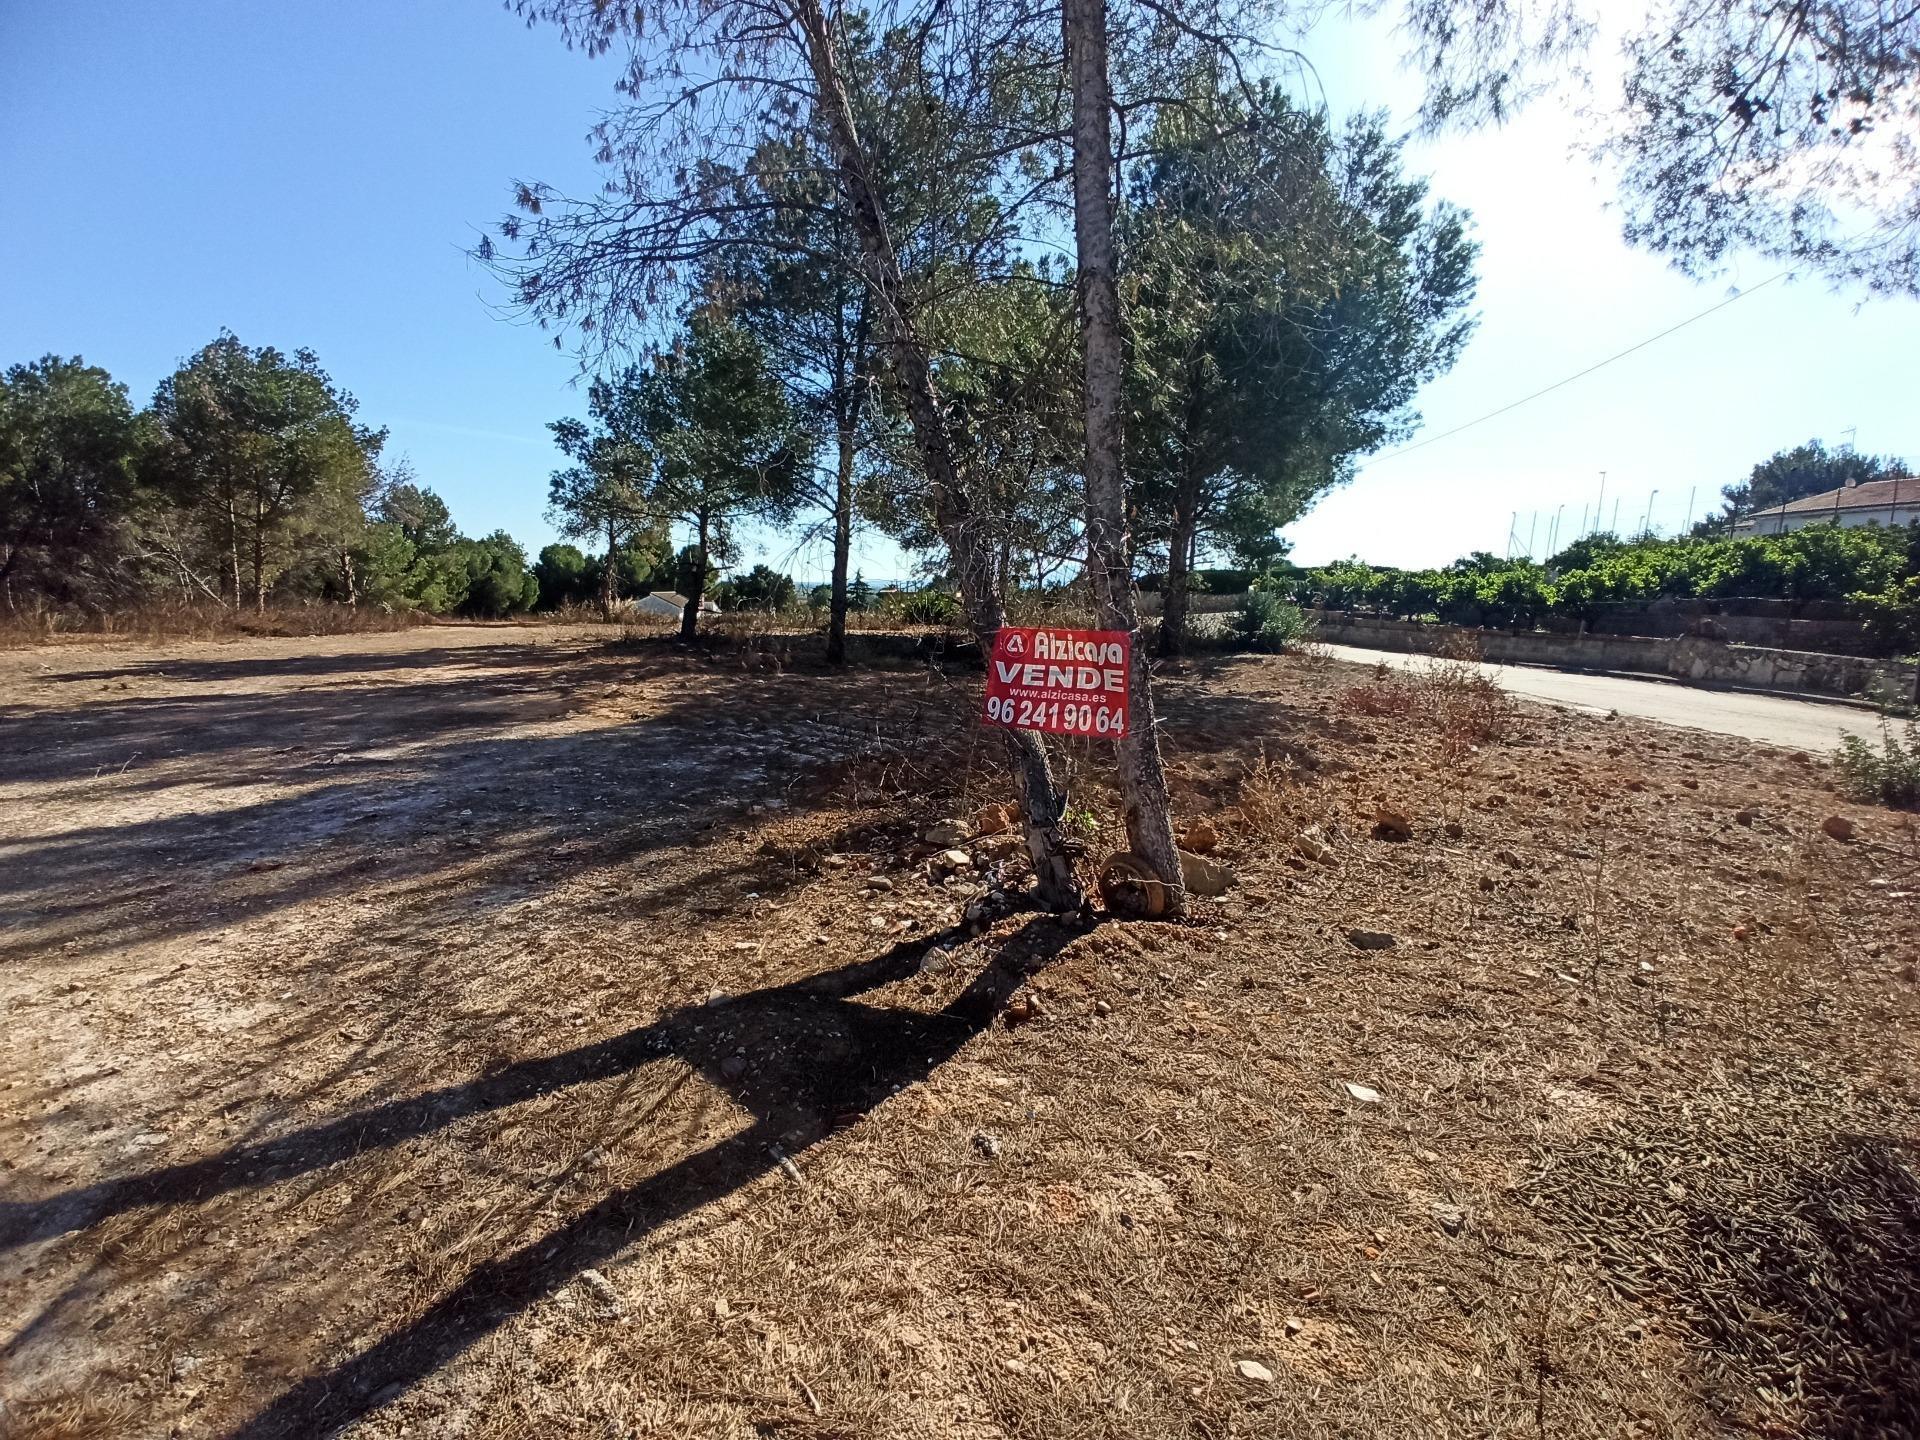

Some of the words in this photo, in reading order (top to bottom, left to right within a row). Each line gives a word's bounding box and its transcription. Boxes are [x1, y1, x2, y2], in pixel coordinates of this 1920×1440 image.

[1034, 631, 1123, 666] Alzicasa
[995, 660, 1125, 693] VENDE
[1009, 688, 1107, 703] www.alzicasa.es
[987, 696, 1016, 724] 96
[1017, 700, 1059, 729] 241
[1063, 703, 1092, 732] 90
[1095, 706, 1125, 734] 64
